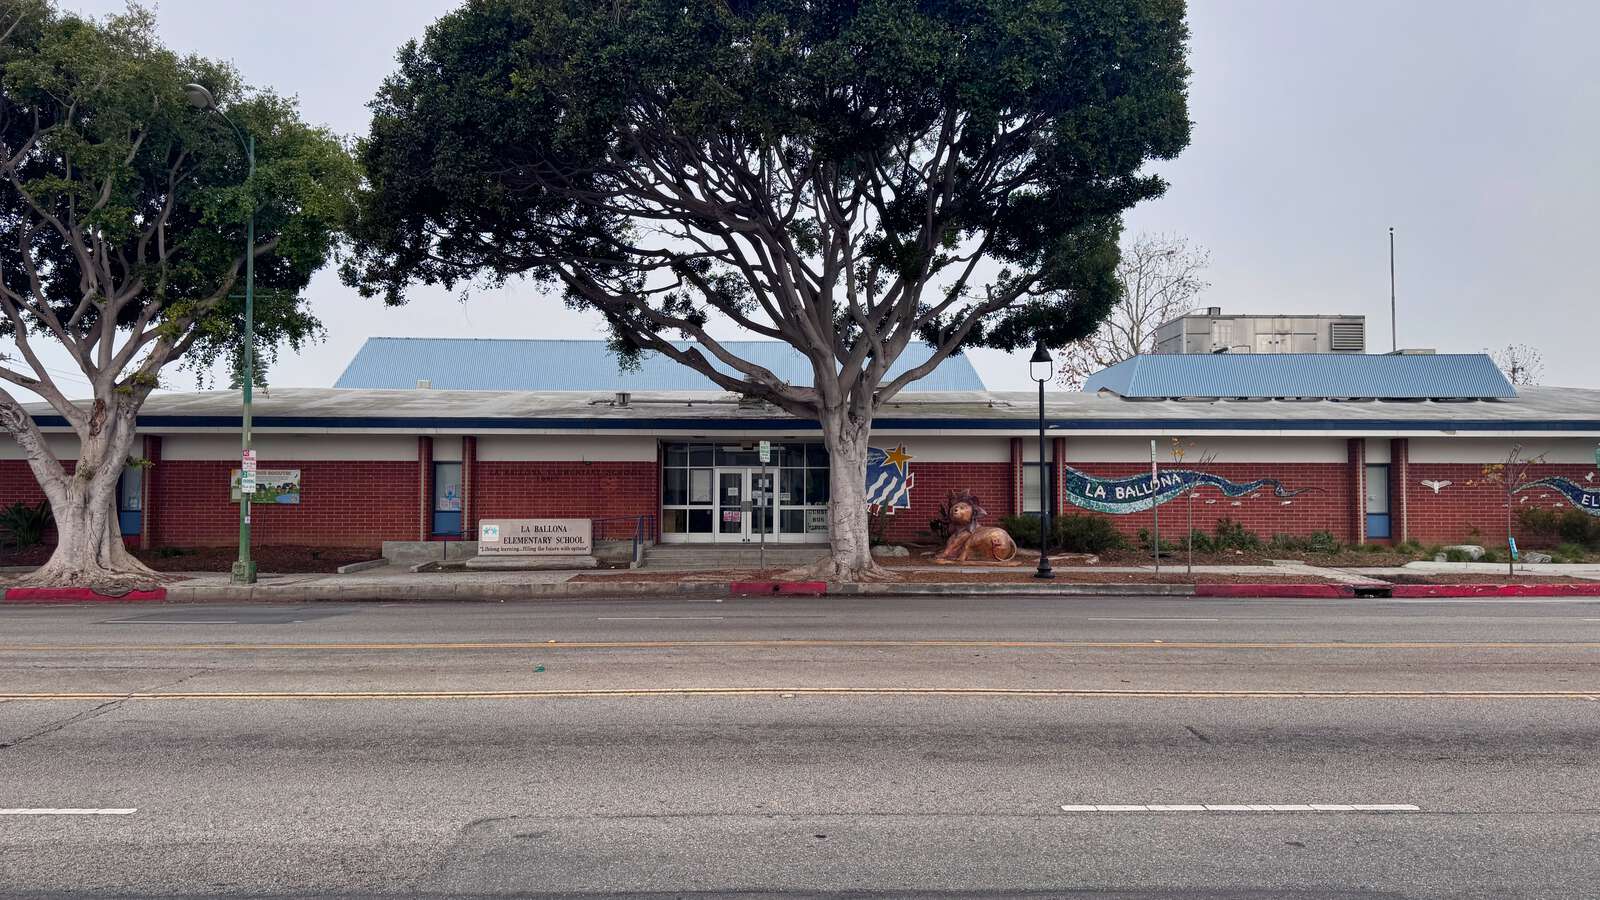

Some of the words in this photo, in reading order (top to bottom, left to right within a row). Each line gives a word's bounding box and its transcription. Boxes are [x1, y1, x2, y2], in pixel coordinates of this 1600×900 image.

[1085, 483, 1106, 499] LA
[1115, 473, 1182, 499] BALLONA
[1581, 494, 1600, 507] EL
[520, 525, 530, 533] LA
[534, 525, 567, 533] BALLONA
[503, 536, 552, 545] ELEMENTARY
[556, 536, 585, 544] SCHOOL
